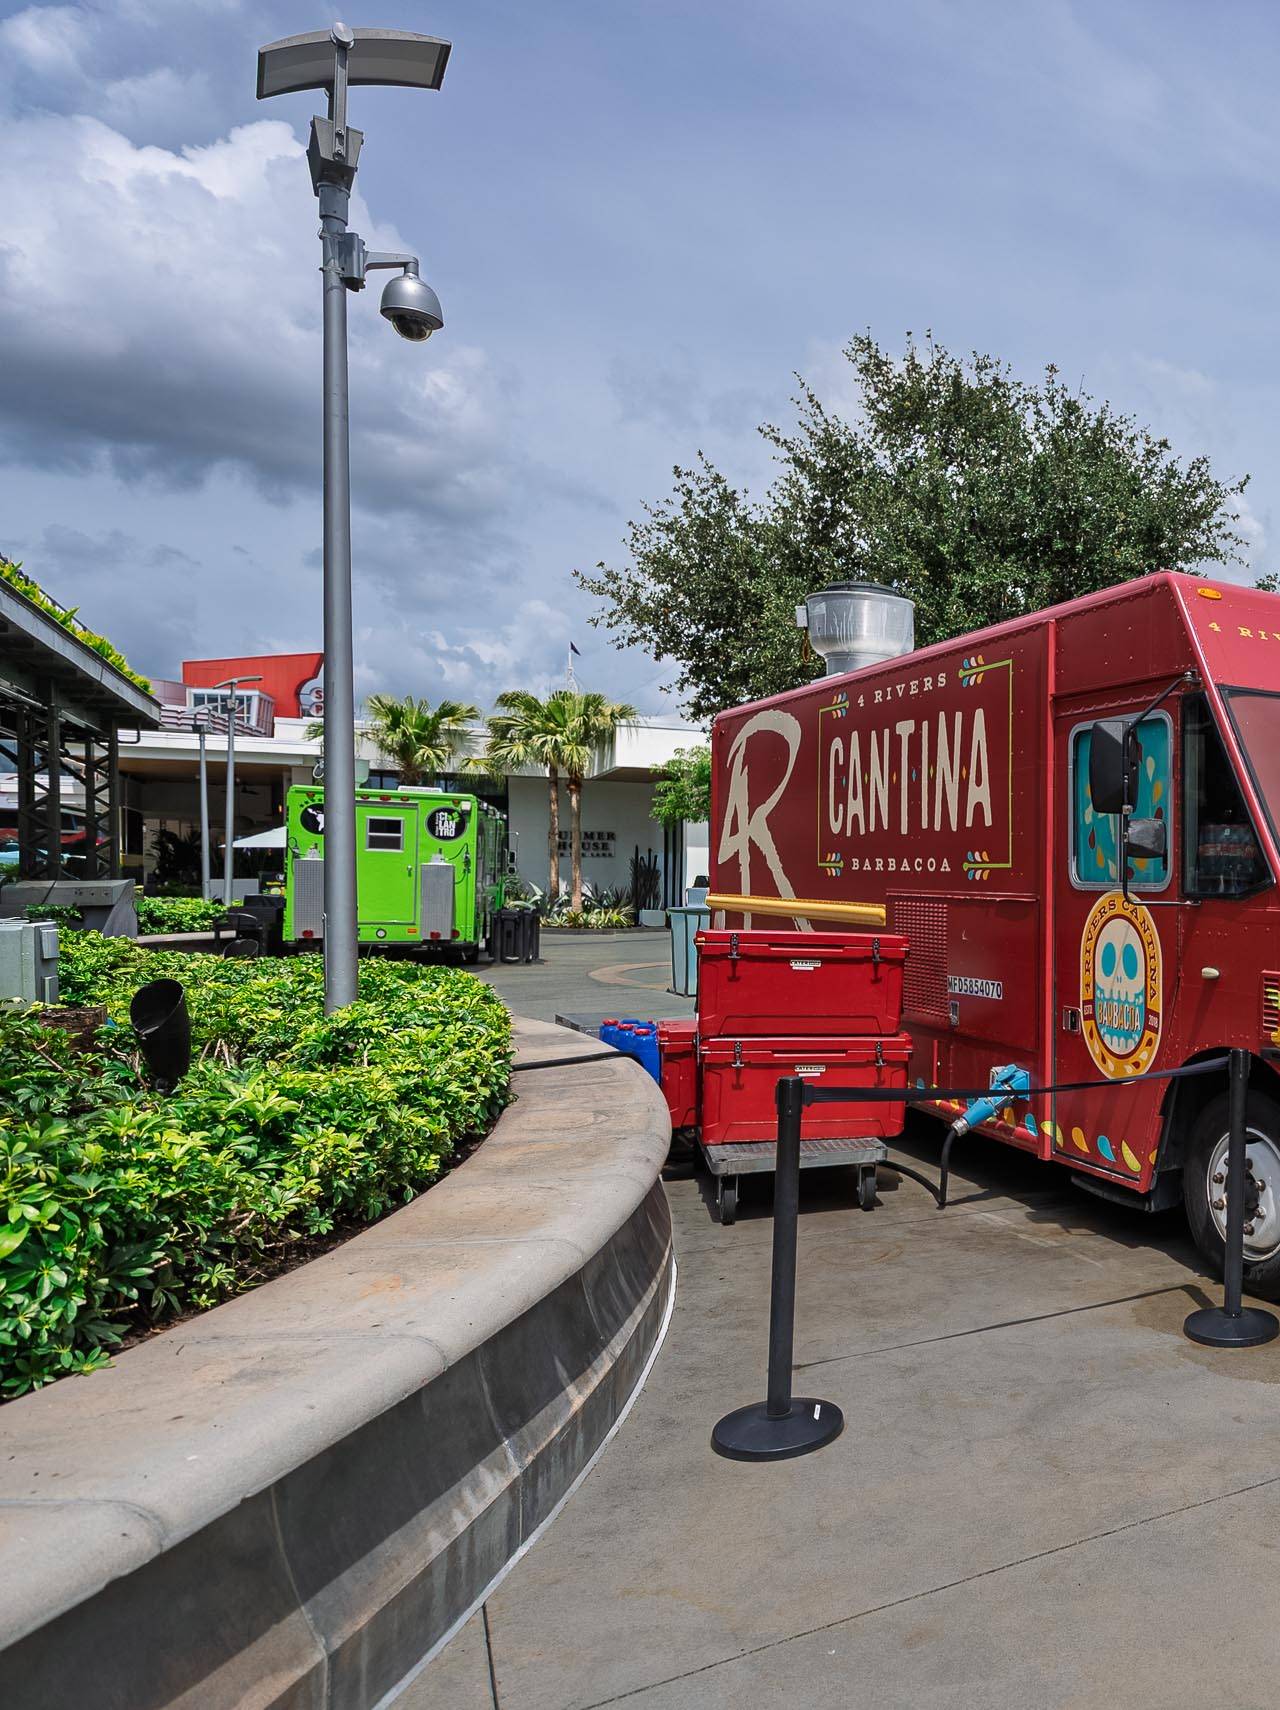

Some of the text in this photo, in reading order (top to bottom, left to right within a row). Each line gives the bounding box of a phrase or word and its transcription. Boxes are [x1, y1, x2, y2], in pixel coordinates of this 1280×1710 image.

[1208, 622, 1221, 632] 4
[857, 673, 947, 707] 4 RIVERS
[828, 708, 993, 837] CANTINA
[548, 831, 616, 841] UMER
[851, 857, 952, 872] BARBACOA
[1084, 899, 1117, 976] RIVERS
[1121, 899, 1158, 1002] CANTINA
[947, 976, 1002, 999] MFD5854070
[1098, 1001, 1142, 1032] BARBACOA
